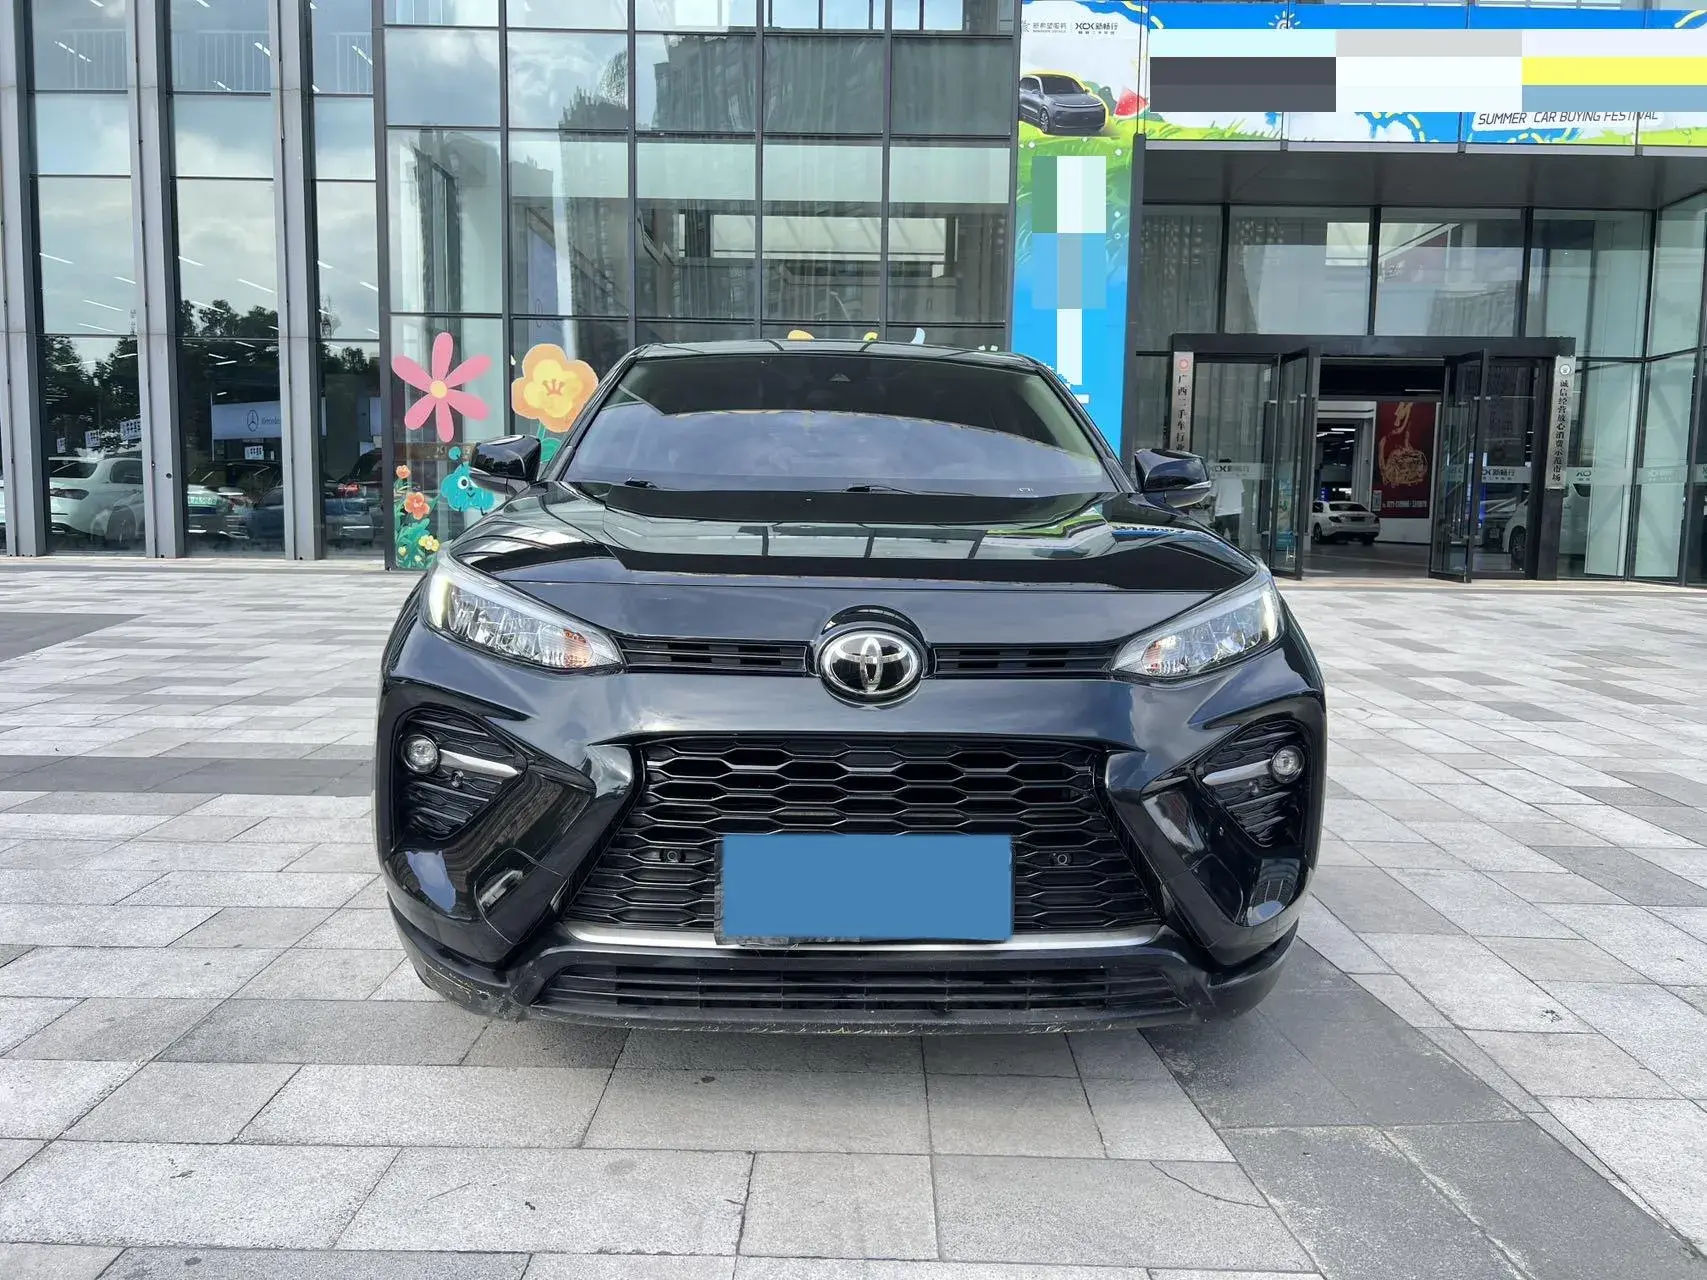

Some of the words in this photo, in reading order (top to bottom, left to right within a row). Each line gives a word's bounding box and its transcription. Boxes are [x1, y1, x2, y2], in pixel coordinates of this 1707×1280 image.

[1478, 112, 1527, 125] SUMMER
[1533, 112, 1556, 123] CAR
[1559, 112, 1601, 122] BUYING
